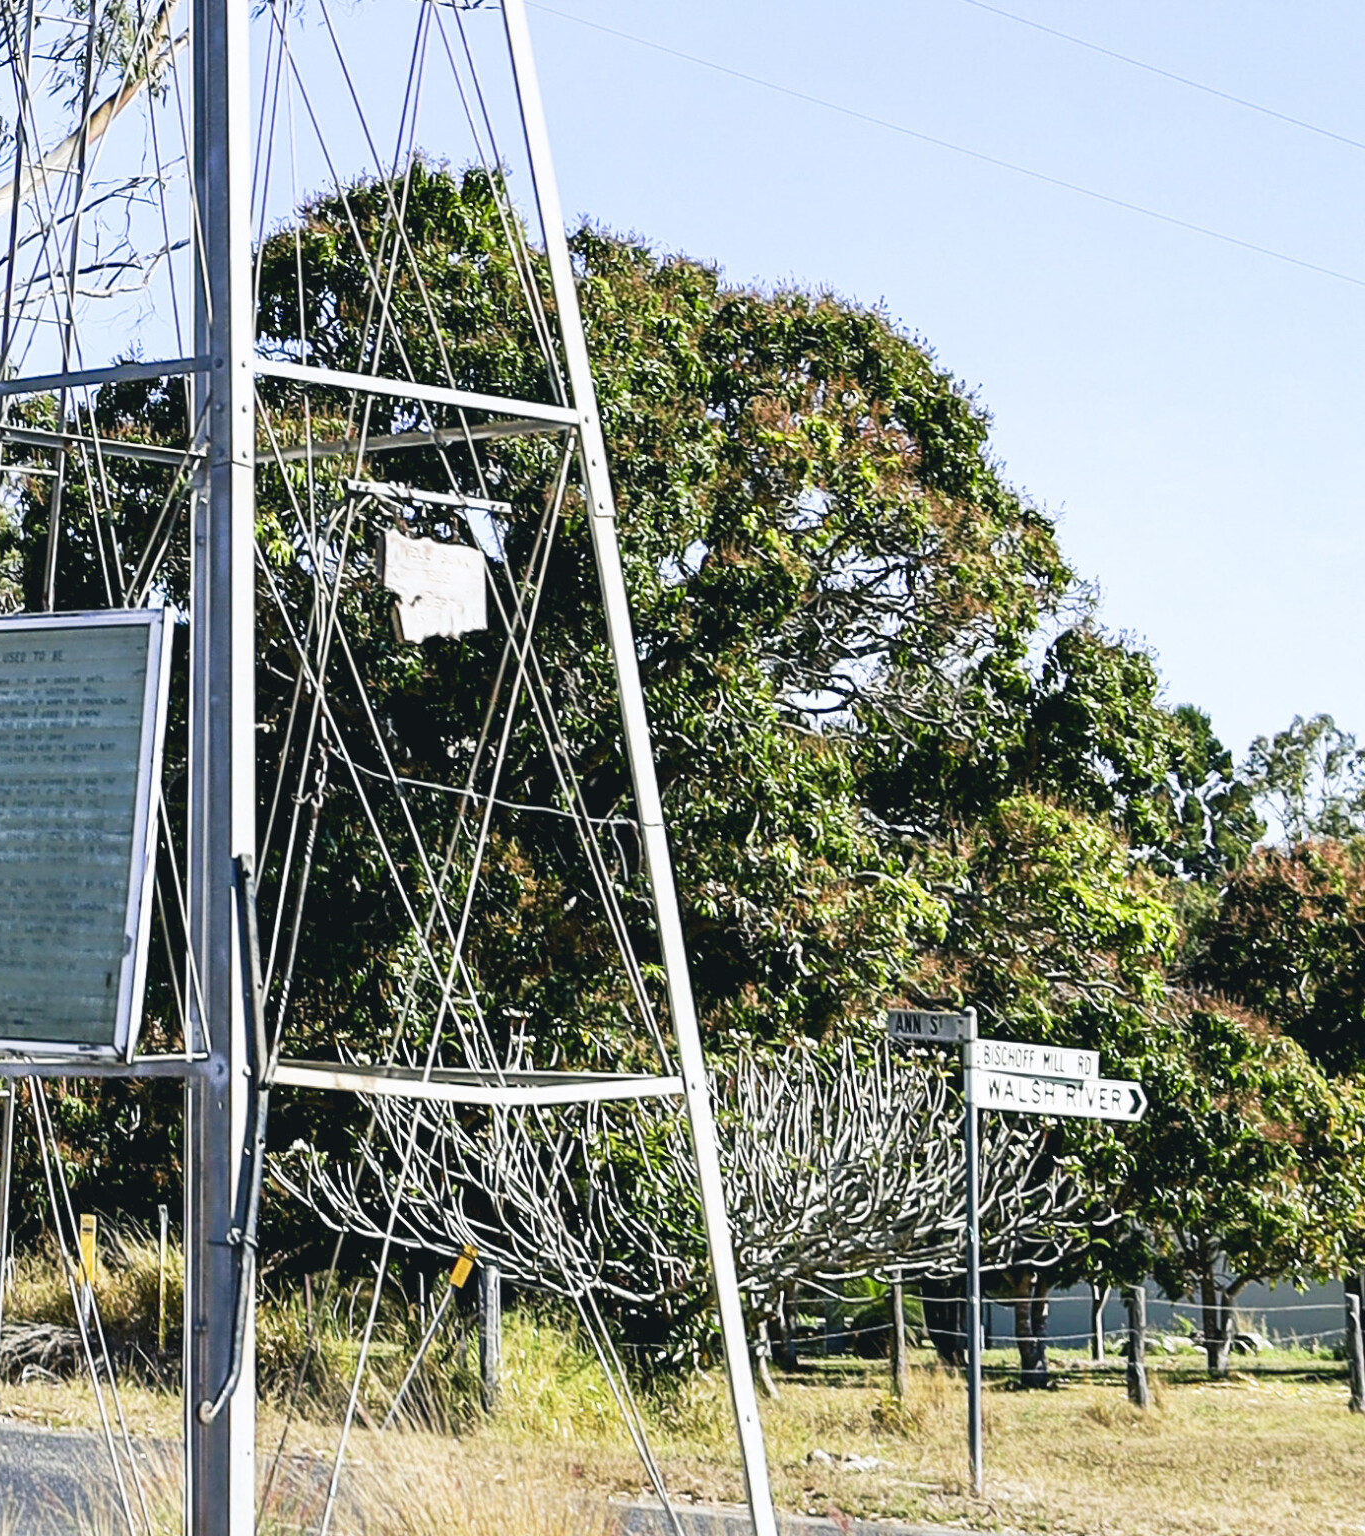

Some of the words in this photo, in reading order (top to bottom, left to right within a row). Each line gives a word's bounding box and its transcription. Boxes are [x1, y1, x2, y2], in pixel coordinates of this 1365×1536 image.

[2, 651, 27, 664] USED
[33, 650, 46, 663] TO
[52, 649, 65, 663] BE
[895, 1012, 922, 1035] ANN
[983, 1044, 1036, 1071] BISCHOFF
[1043, 1051, 1066, 1074] MILL
[1077, 1055, 1093, 1076] RD
[987, 1078, 1056, 1106] WALSH
[1065, 1084, 1123, 1112] RIVER
